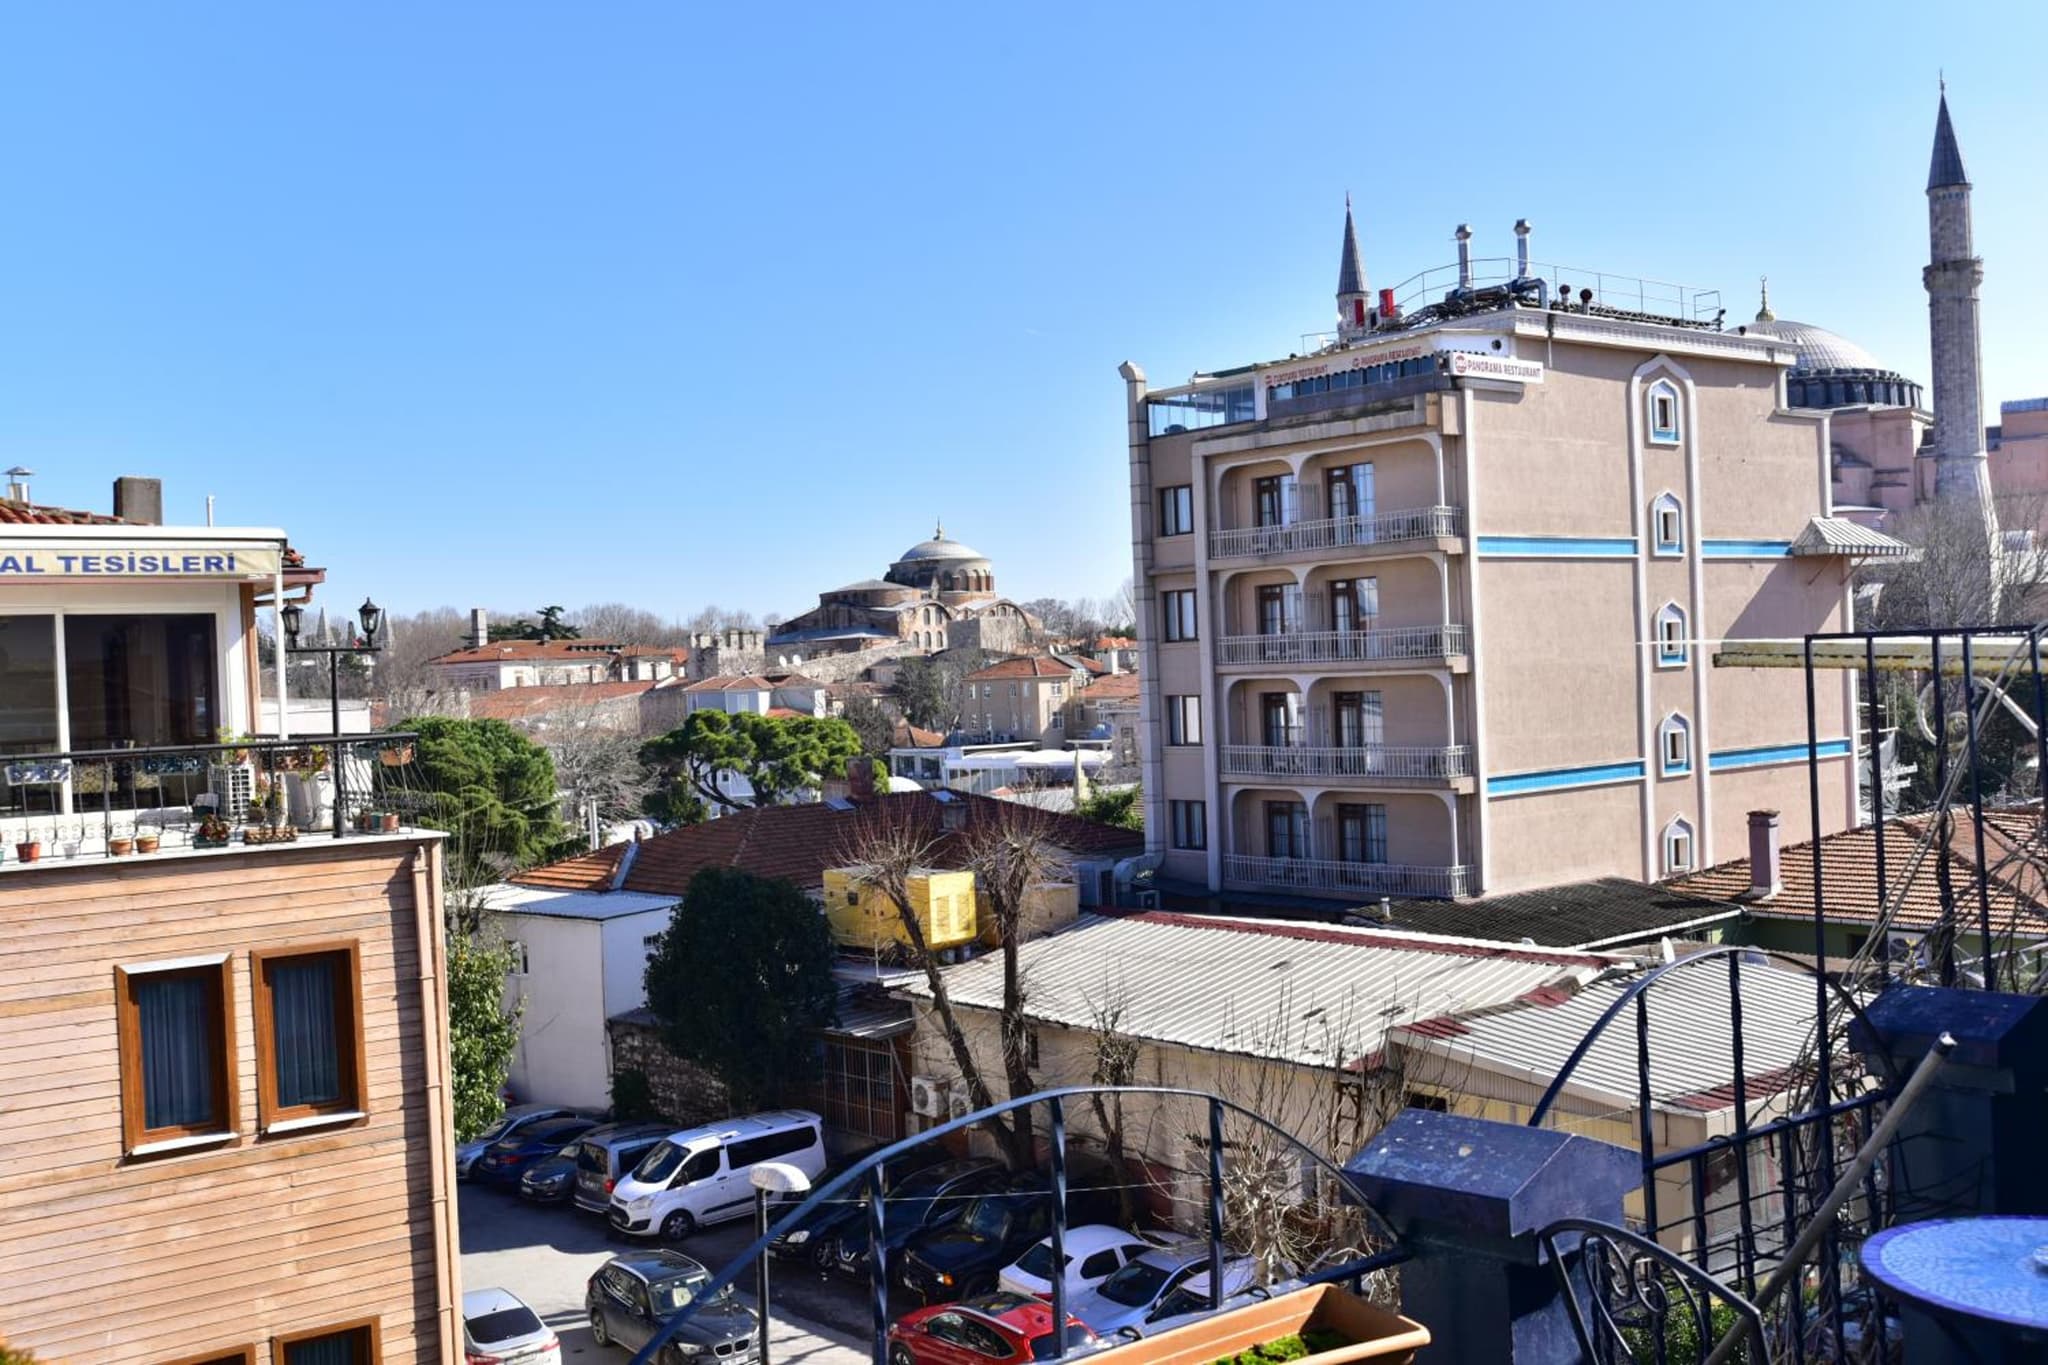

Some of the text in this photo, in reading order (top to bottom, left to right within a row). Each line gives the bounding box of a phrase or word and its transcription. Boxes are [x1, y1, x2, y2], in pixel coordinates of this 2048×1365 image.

[1467, 360, 1541, 377] PANORAMA RESTAURANT
[0, 552, 235, 573] AL TESİSLERİ
